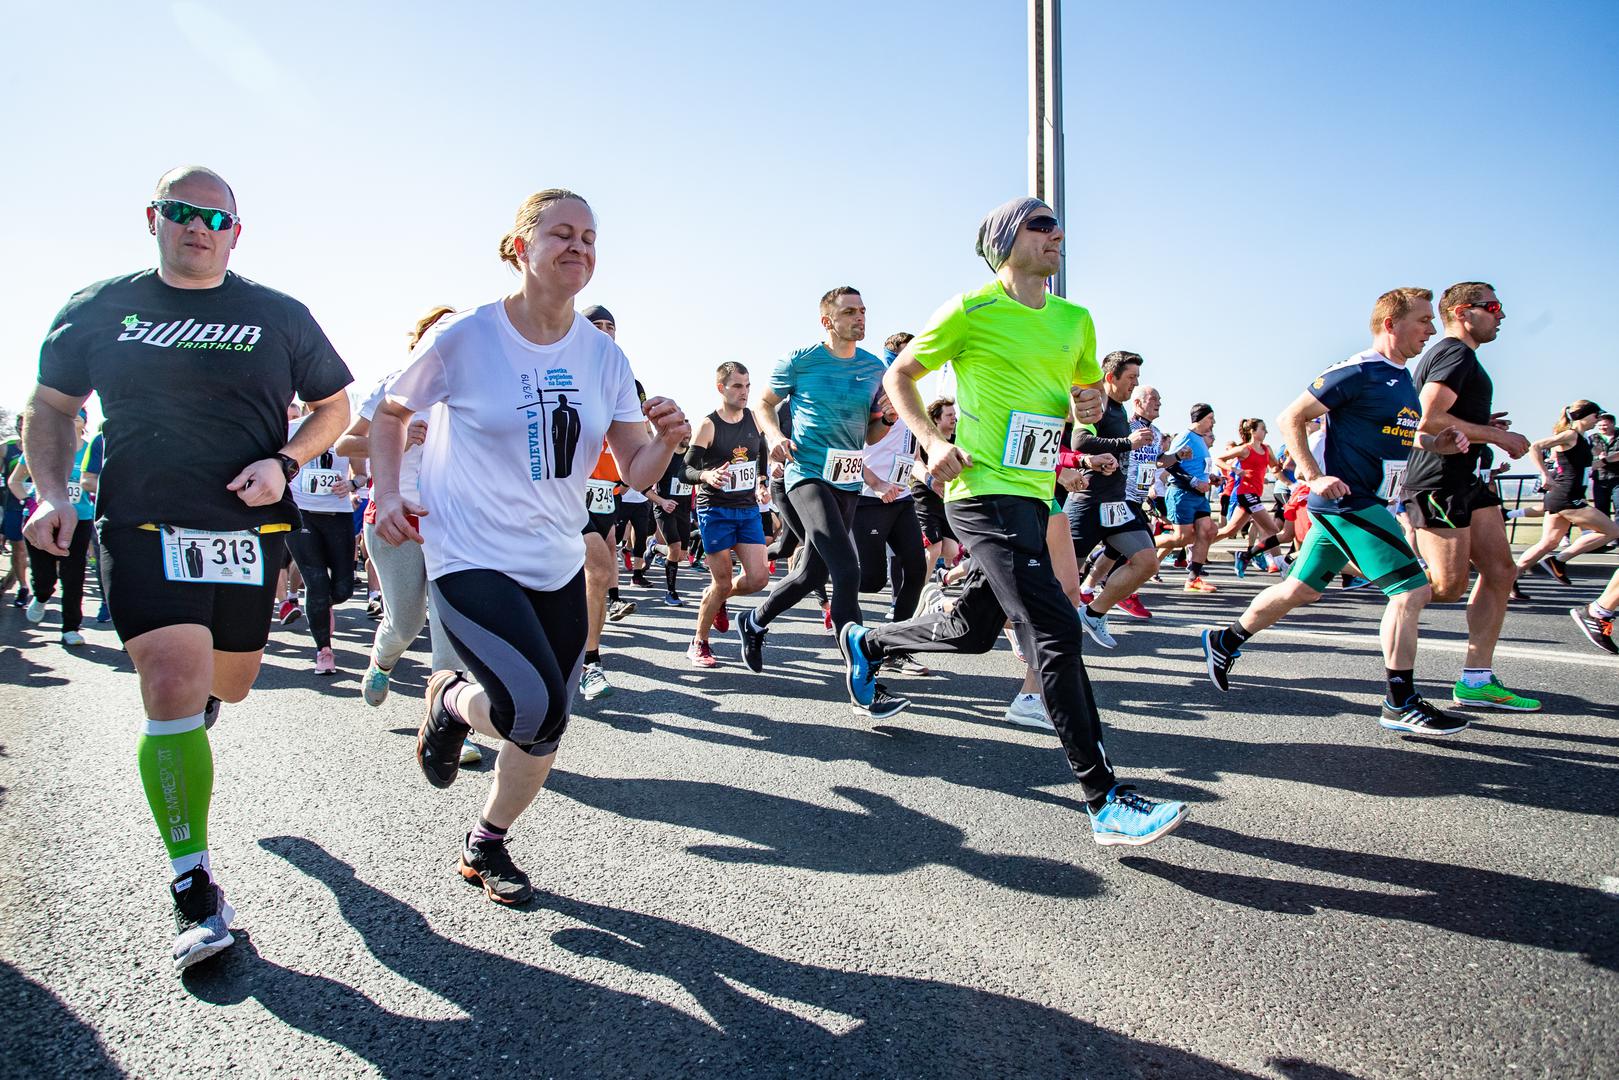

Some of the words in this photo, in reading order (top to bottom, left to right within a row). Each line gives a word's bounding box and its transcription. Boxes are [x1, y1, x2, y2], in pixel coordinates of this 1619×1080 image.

[175, 341, 254, 352] TRIATHLON
[521, 373, 533, 400] 3/3/19
[526, 410, 538, 419] V
[528, 421, 542, 481] HOLJEVKA
[1040, 429, 1061, 454] 29
[739, 467, 755, 481] 168
[843, 457, 863, 473] 389
[211, 538, 257, 565] 313
